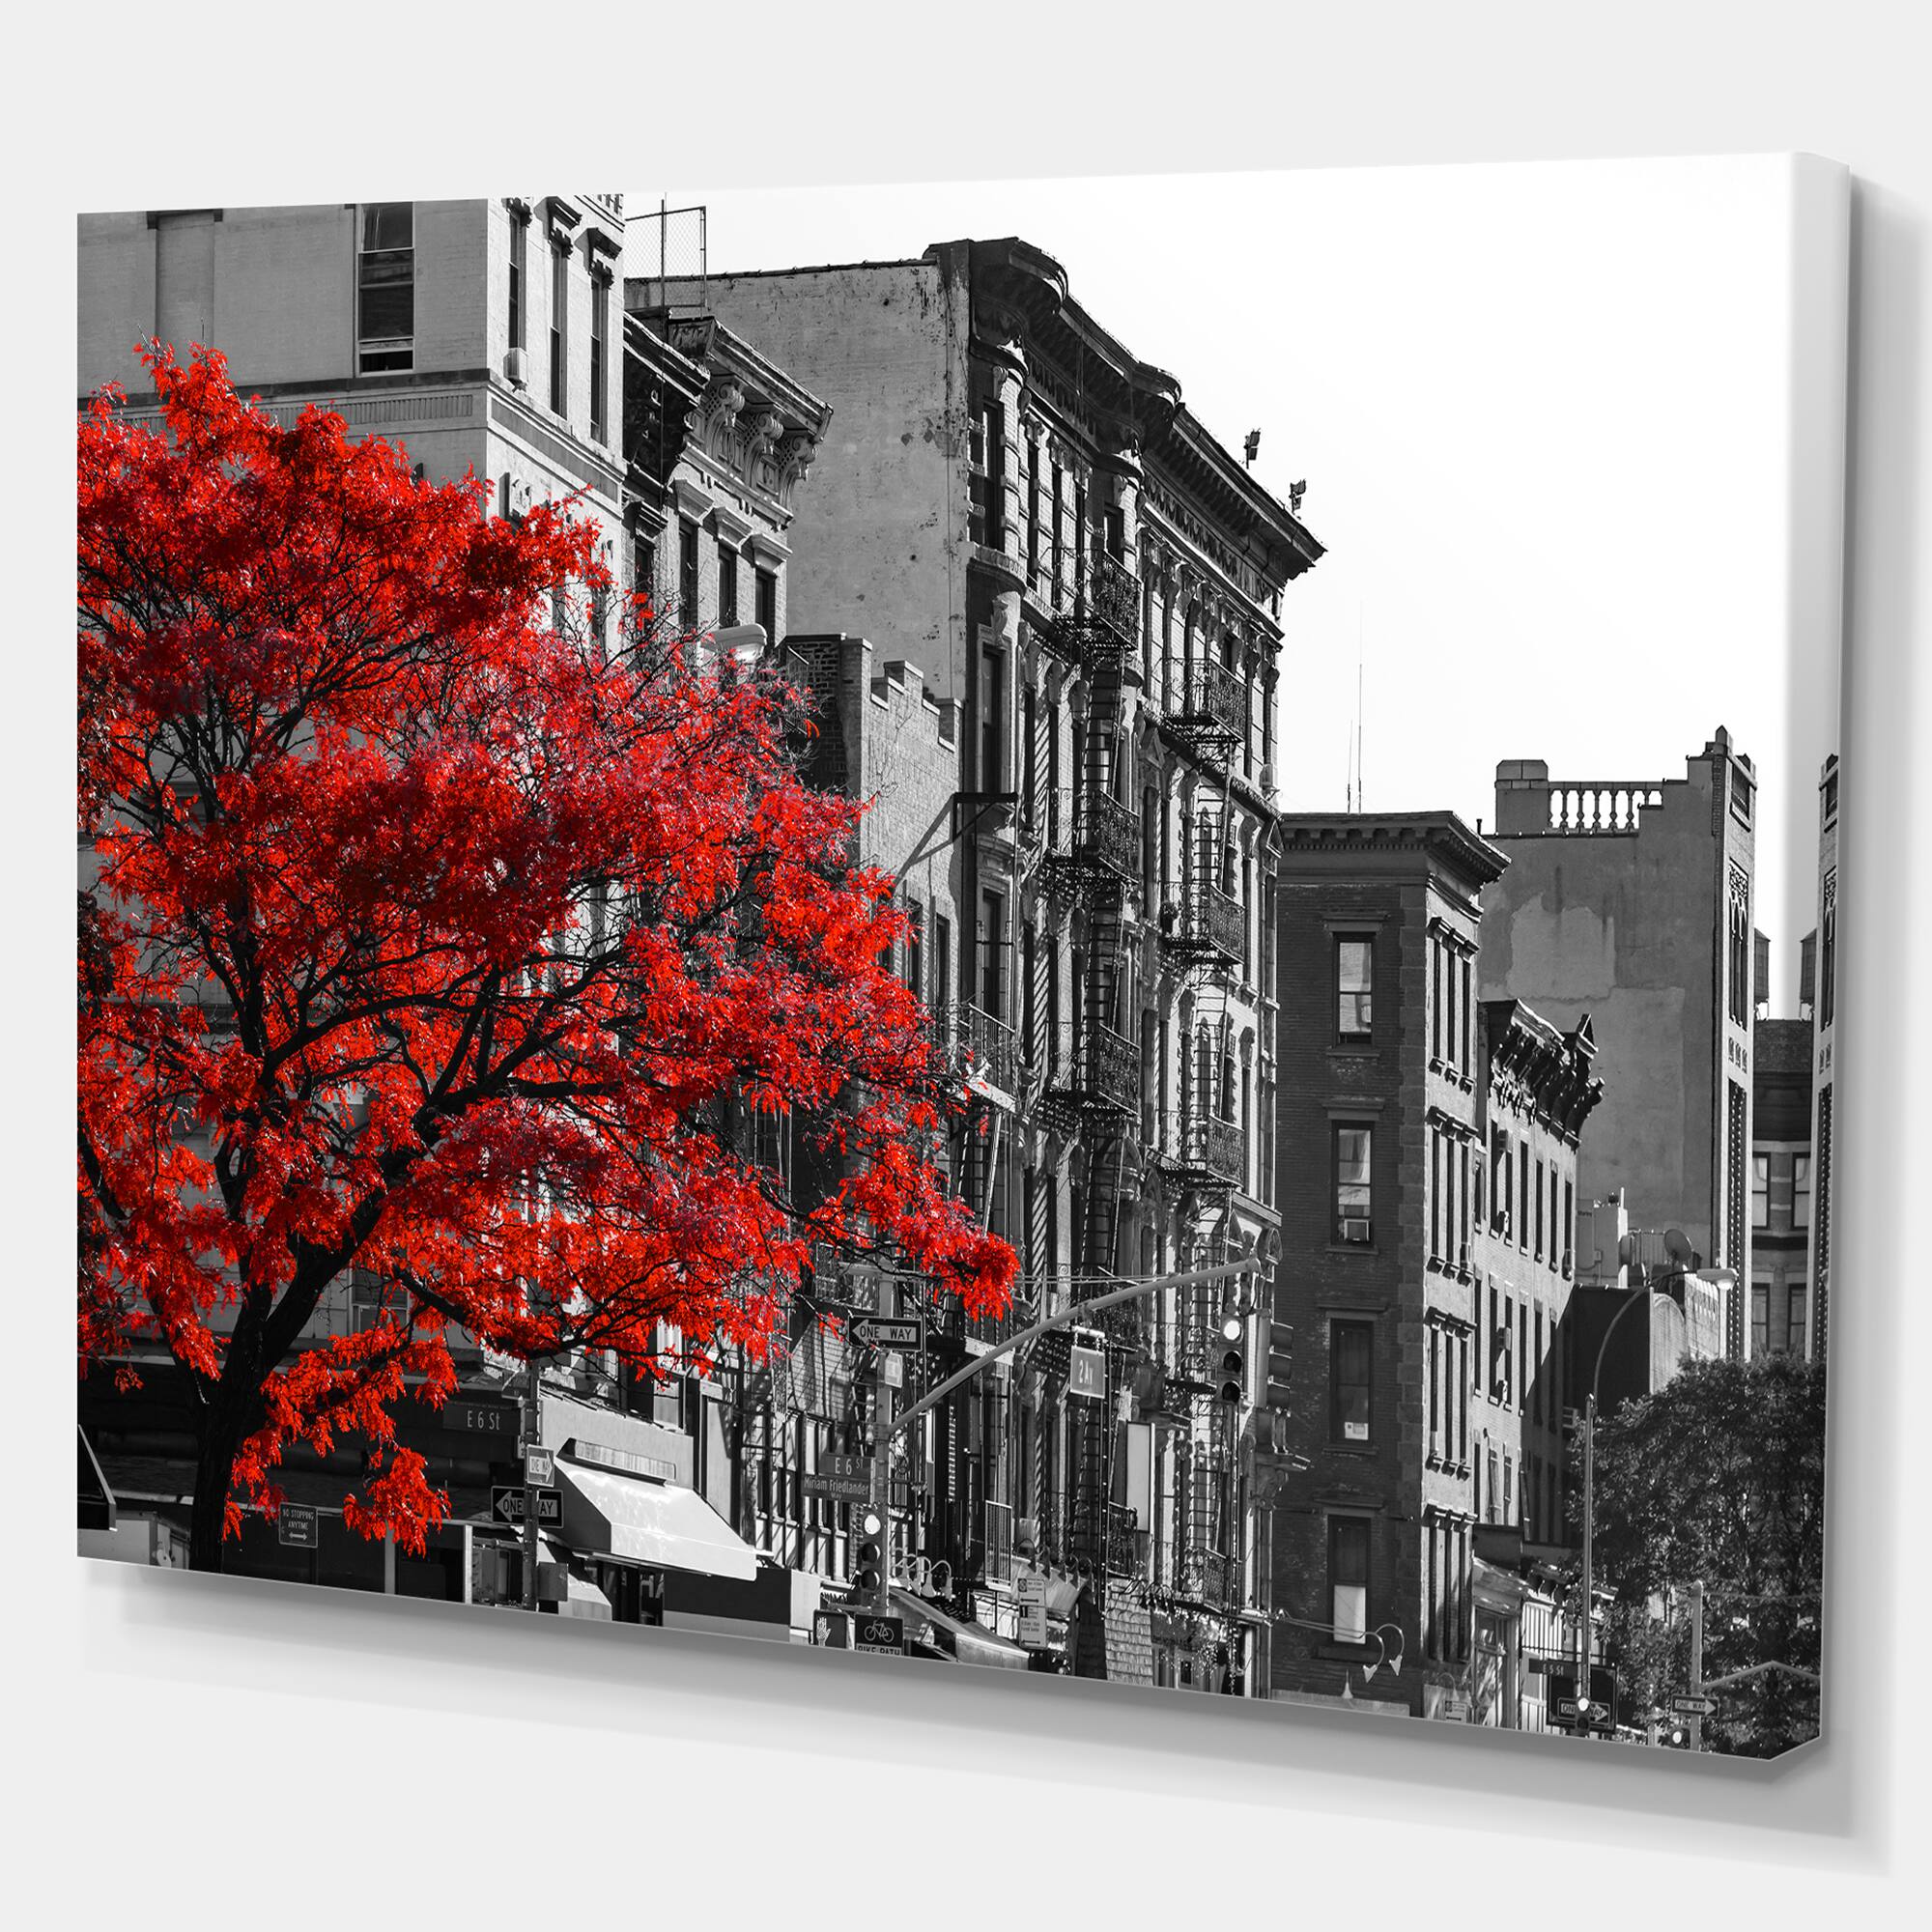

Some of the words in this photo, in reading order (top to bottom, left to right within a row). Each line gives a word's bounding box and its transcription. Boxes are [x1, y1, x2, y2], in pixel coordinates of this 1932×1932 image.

[860, 1325, 880, 1339] ONE
[890, 1327, 912, 1340] WAY
[467, 1410, 473, 1428] E
[477, 1410, 485, 1430] 6
[489, 1412, 500, 1431] St
[835, 1457, 841, 1474] E
[845, 1458, 853, 1476] 6
[502, 1498, 524, 1514] ONE
